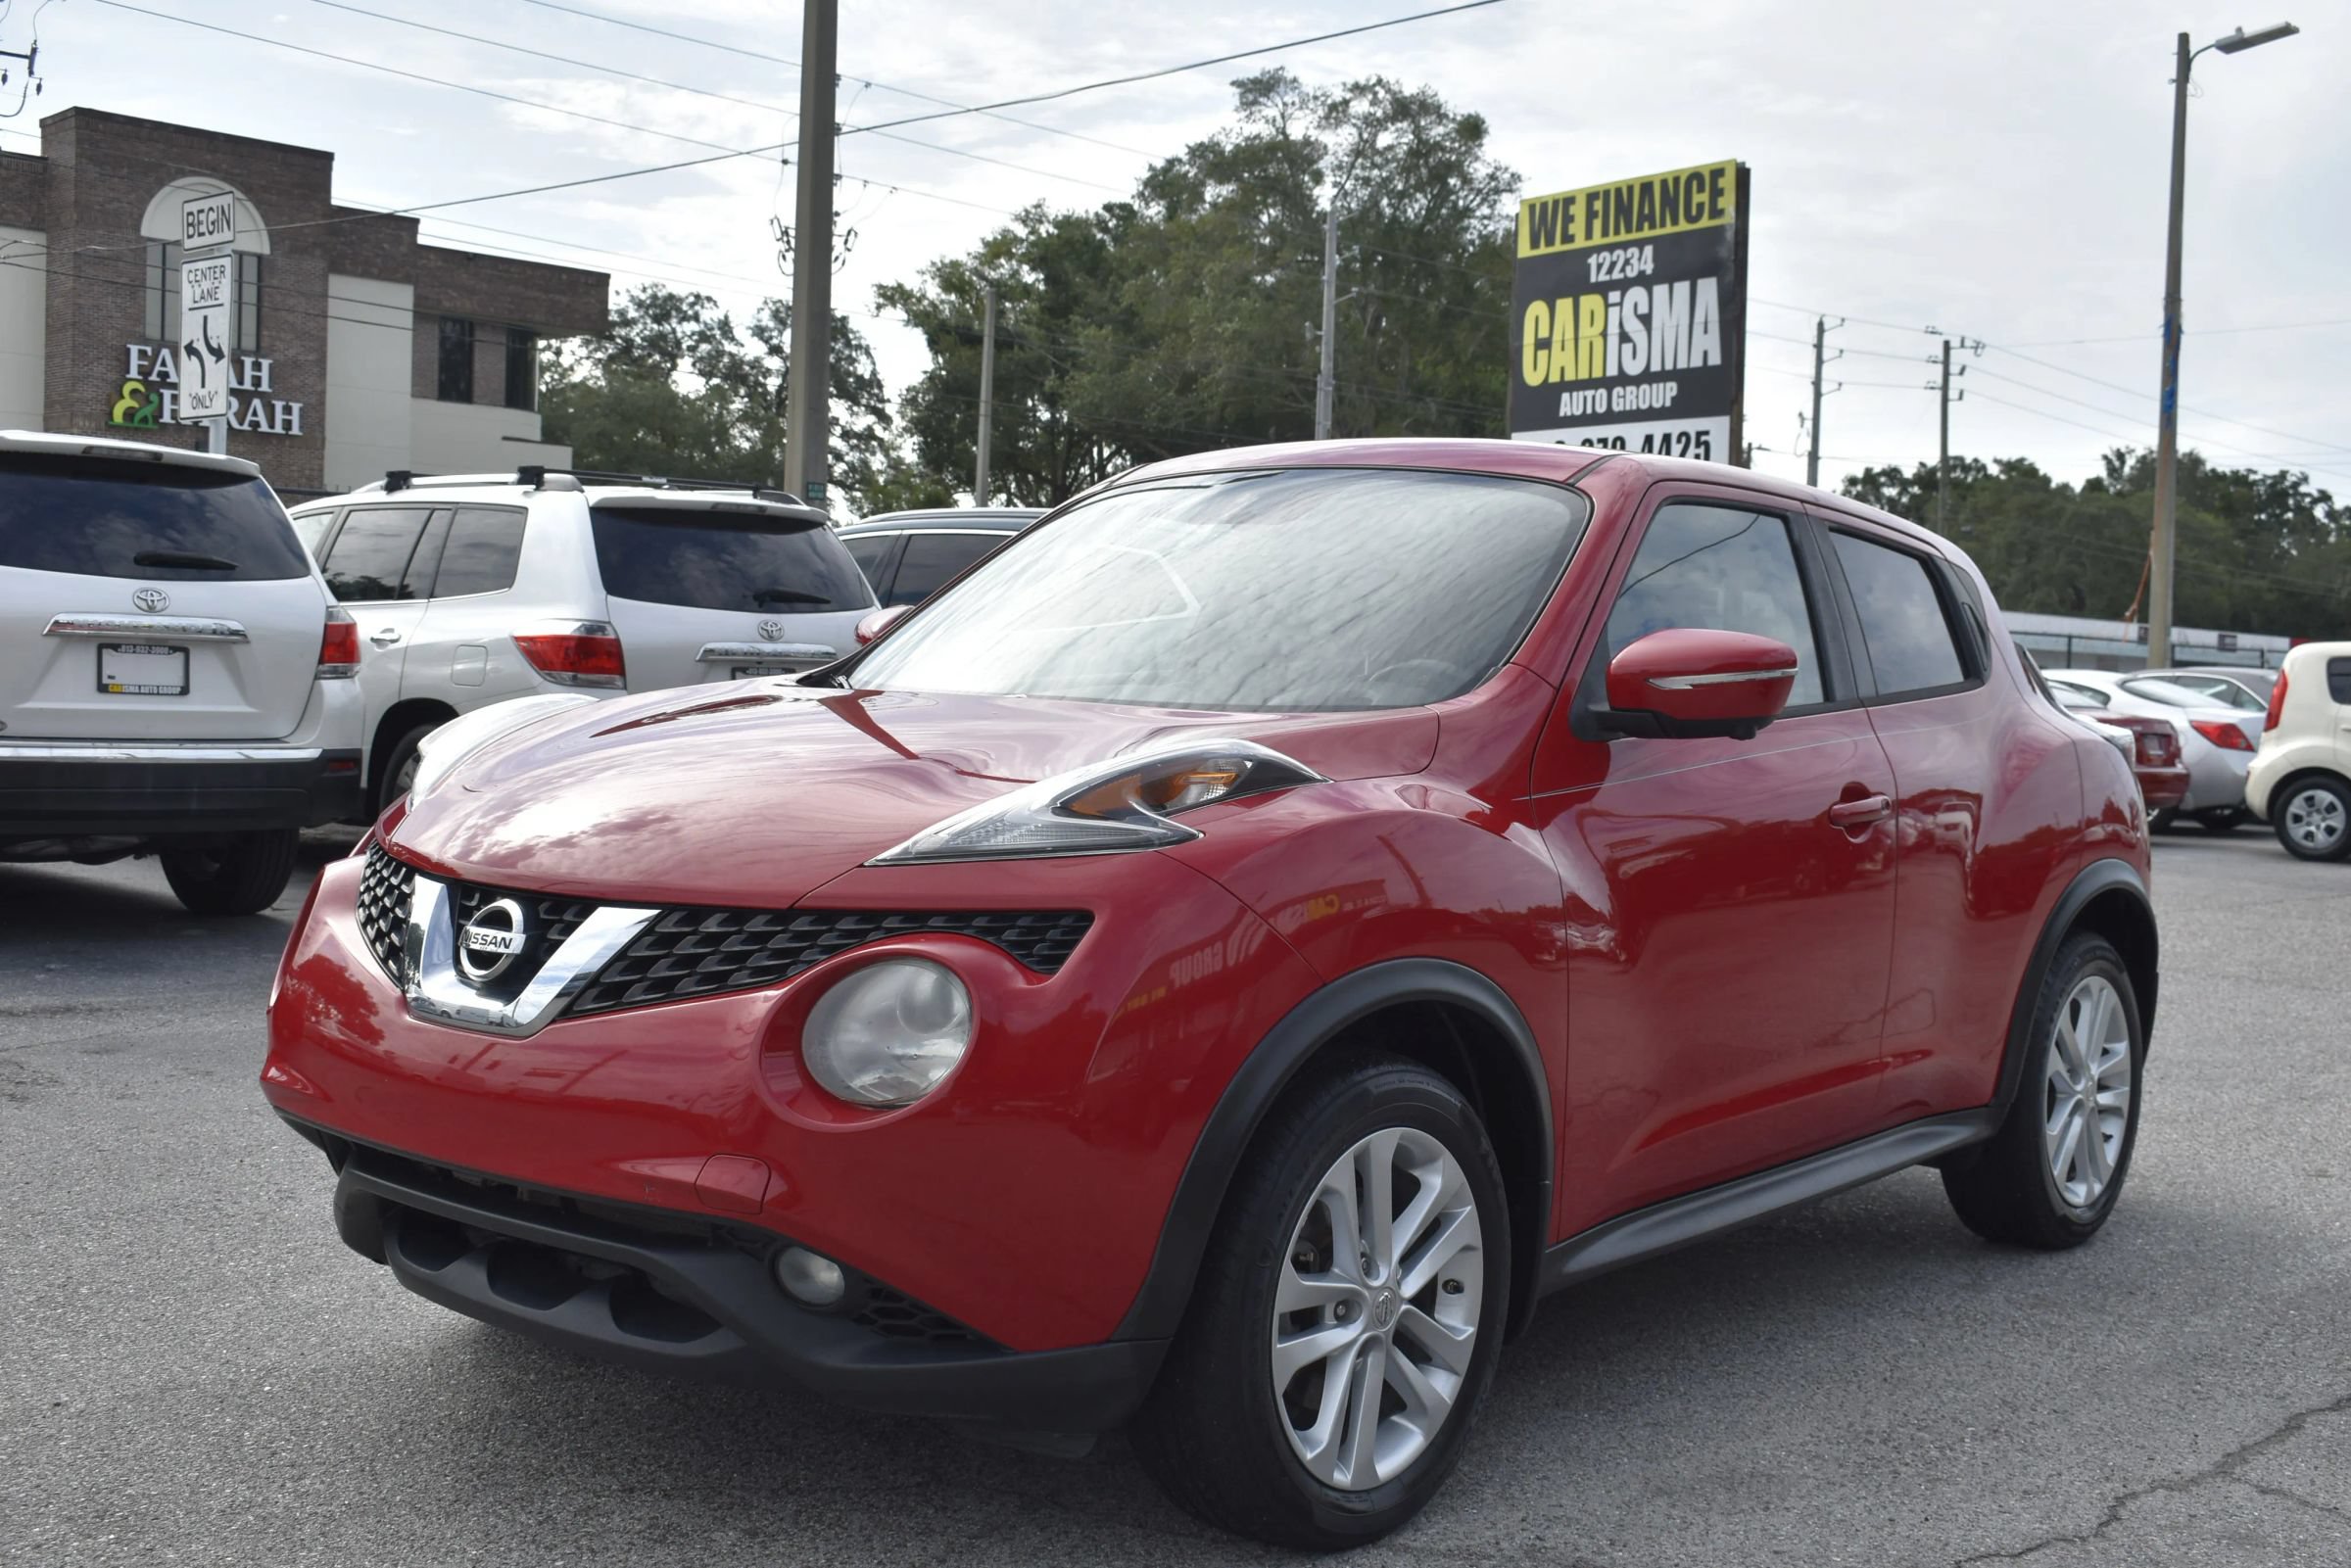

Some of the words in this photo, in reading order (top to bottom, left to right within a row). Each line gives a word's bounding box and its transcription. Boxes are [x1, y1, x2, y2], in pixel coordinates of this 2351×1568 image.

[185, 203, 231, 240] BEGIN
[1528, 196, 1576, 251] WE
[1584, 166, 1726, 241] FINANCE
[187, 264, 226, 285] CENTER
[1587, 244, 1655, 283] 12234
[192, 285, 220, 305] LANE
[125, 344, 274, 393] FAH
[159, 388, 305, 436] FRAH
[1559, 388, 1608, 417] AUTO
[1611, 381, 1678, 412] GROUP
[462, 927, 513, 950] NISSAN
